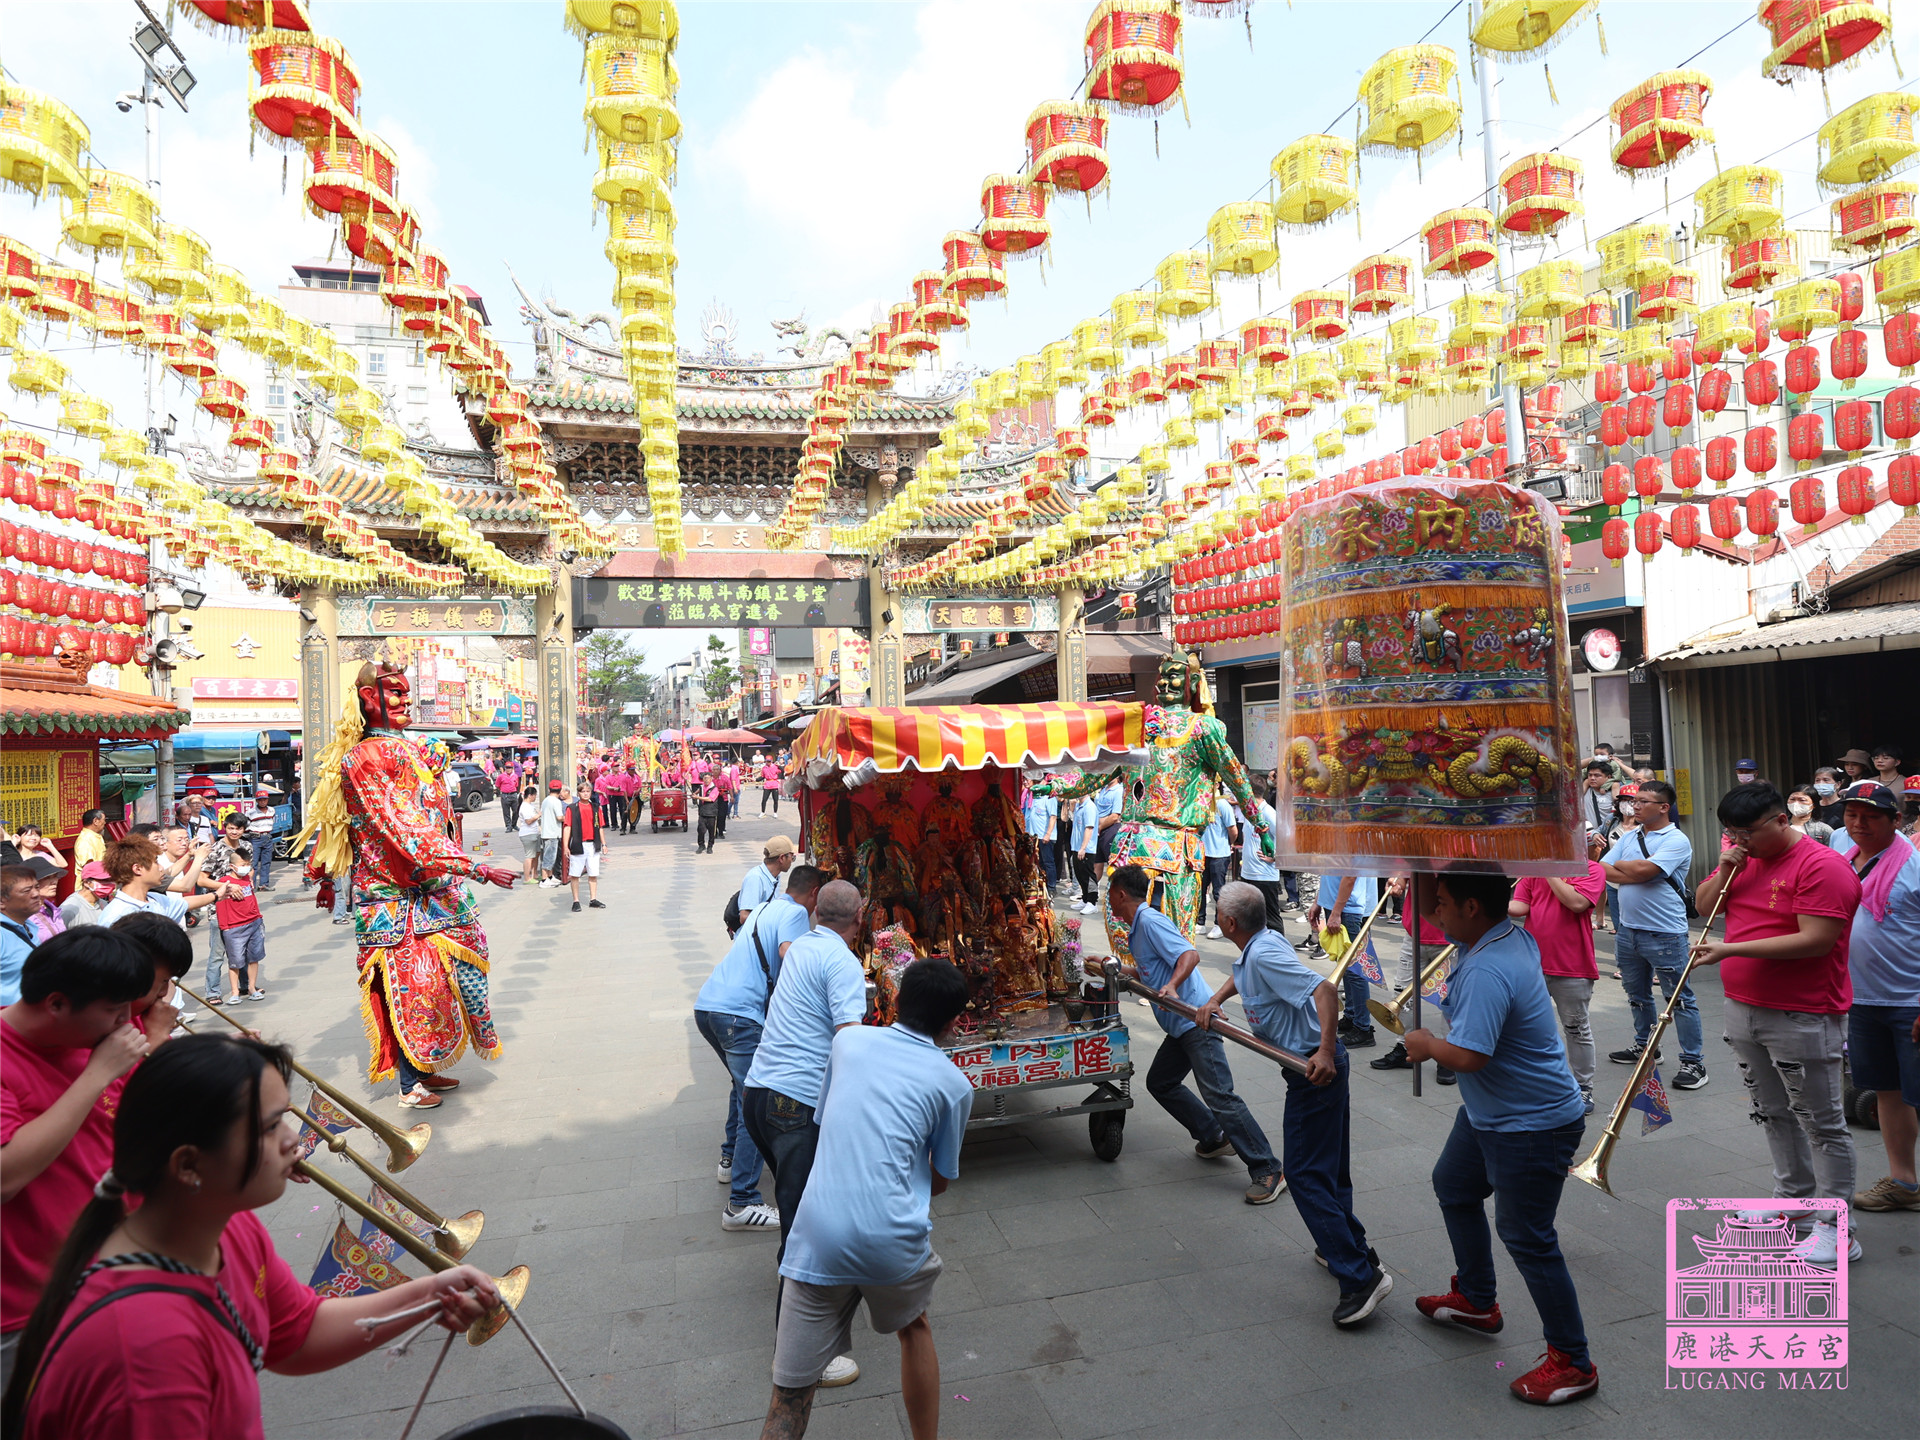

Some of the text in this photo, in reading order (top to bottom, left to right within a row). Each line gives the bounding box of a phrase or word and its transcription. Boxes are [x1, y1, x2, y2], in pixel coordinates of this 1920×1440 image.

[617, 583, 827, 602] 歡迎雲林縣斗南鎮正善堂
[202, 679, 290, 696] 百年老店
[886, 653, 896, 706] 天上天水德
[1073, 1035, 1114, 1077] 隆
